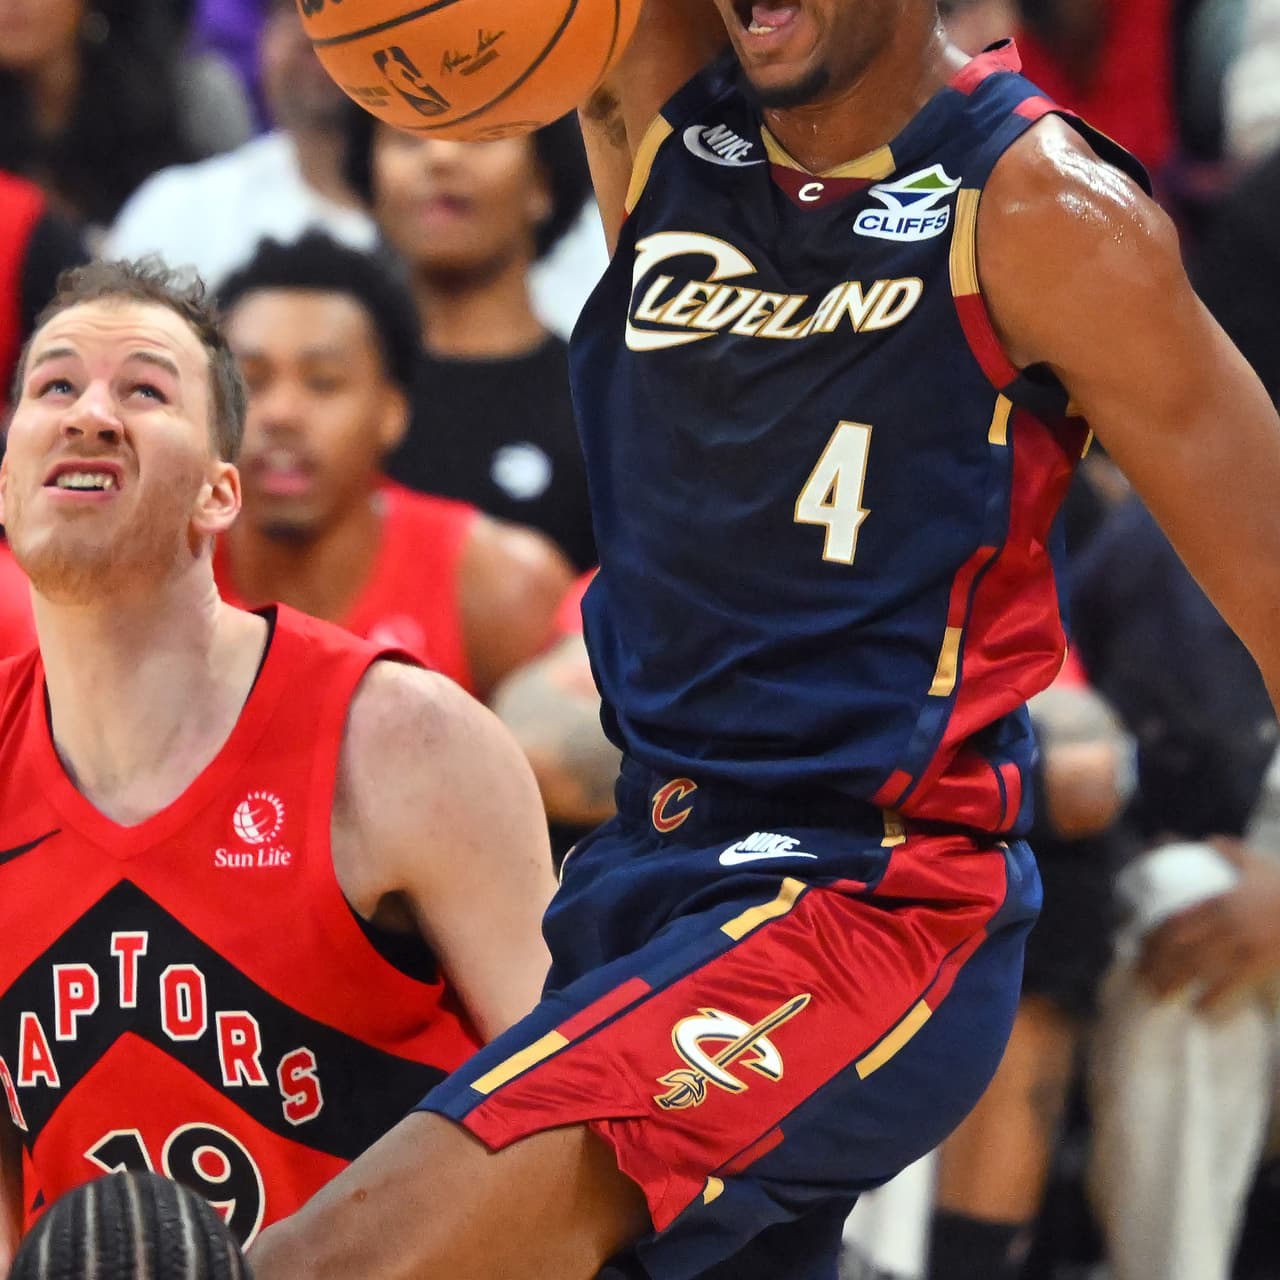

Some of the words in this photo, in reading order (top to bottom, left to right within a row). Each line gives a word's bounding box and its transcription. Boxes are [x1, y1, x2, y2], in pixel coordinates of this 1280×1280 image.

[701, 122, 754, 162] NIKE
[798, 182, 825, 202] C
[858, 212, 948, 234] CLIFFS
[624, 230, 924, 352] CLEVELAND
[793, 419, 872, 566] 4
[651, 777, 699, 833] C
[214, 847, 254, 868] Sun
[257, 844, 292, 867] Life
[735, 831, 801, 854] NIKE
